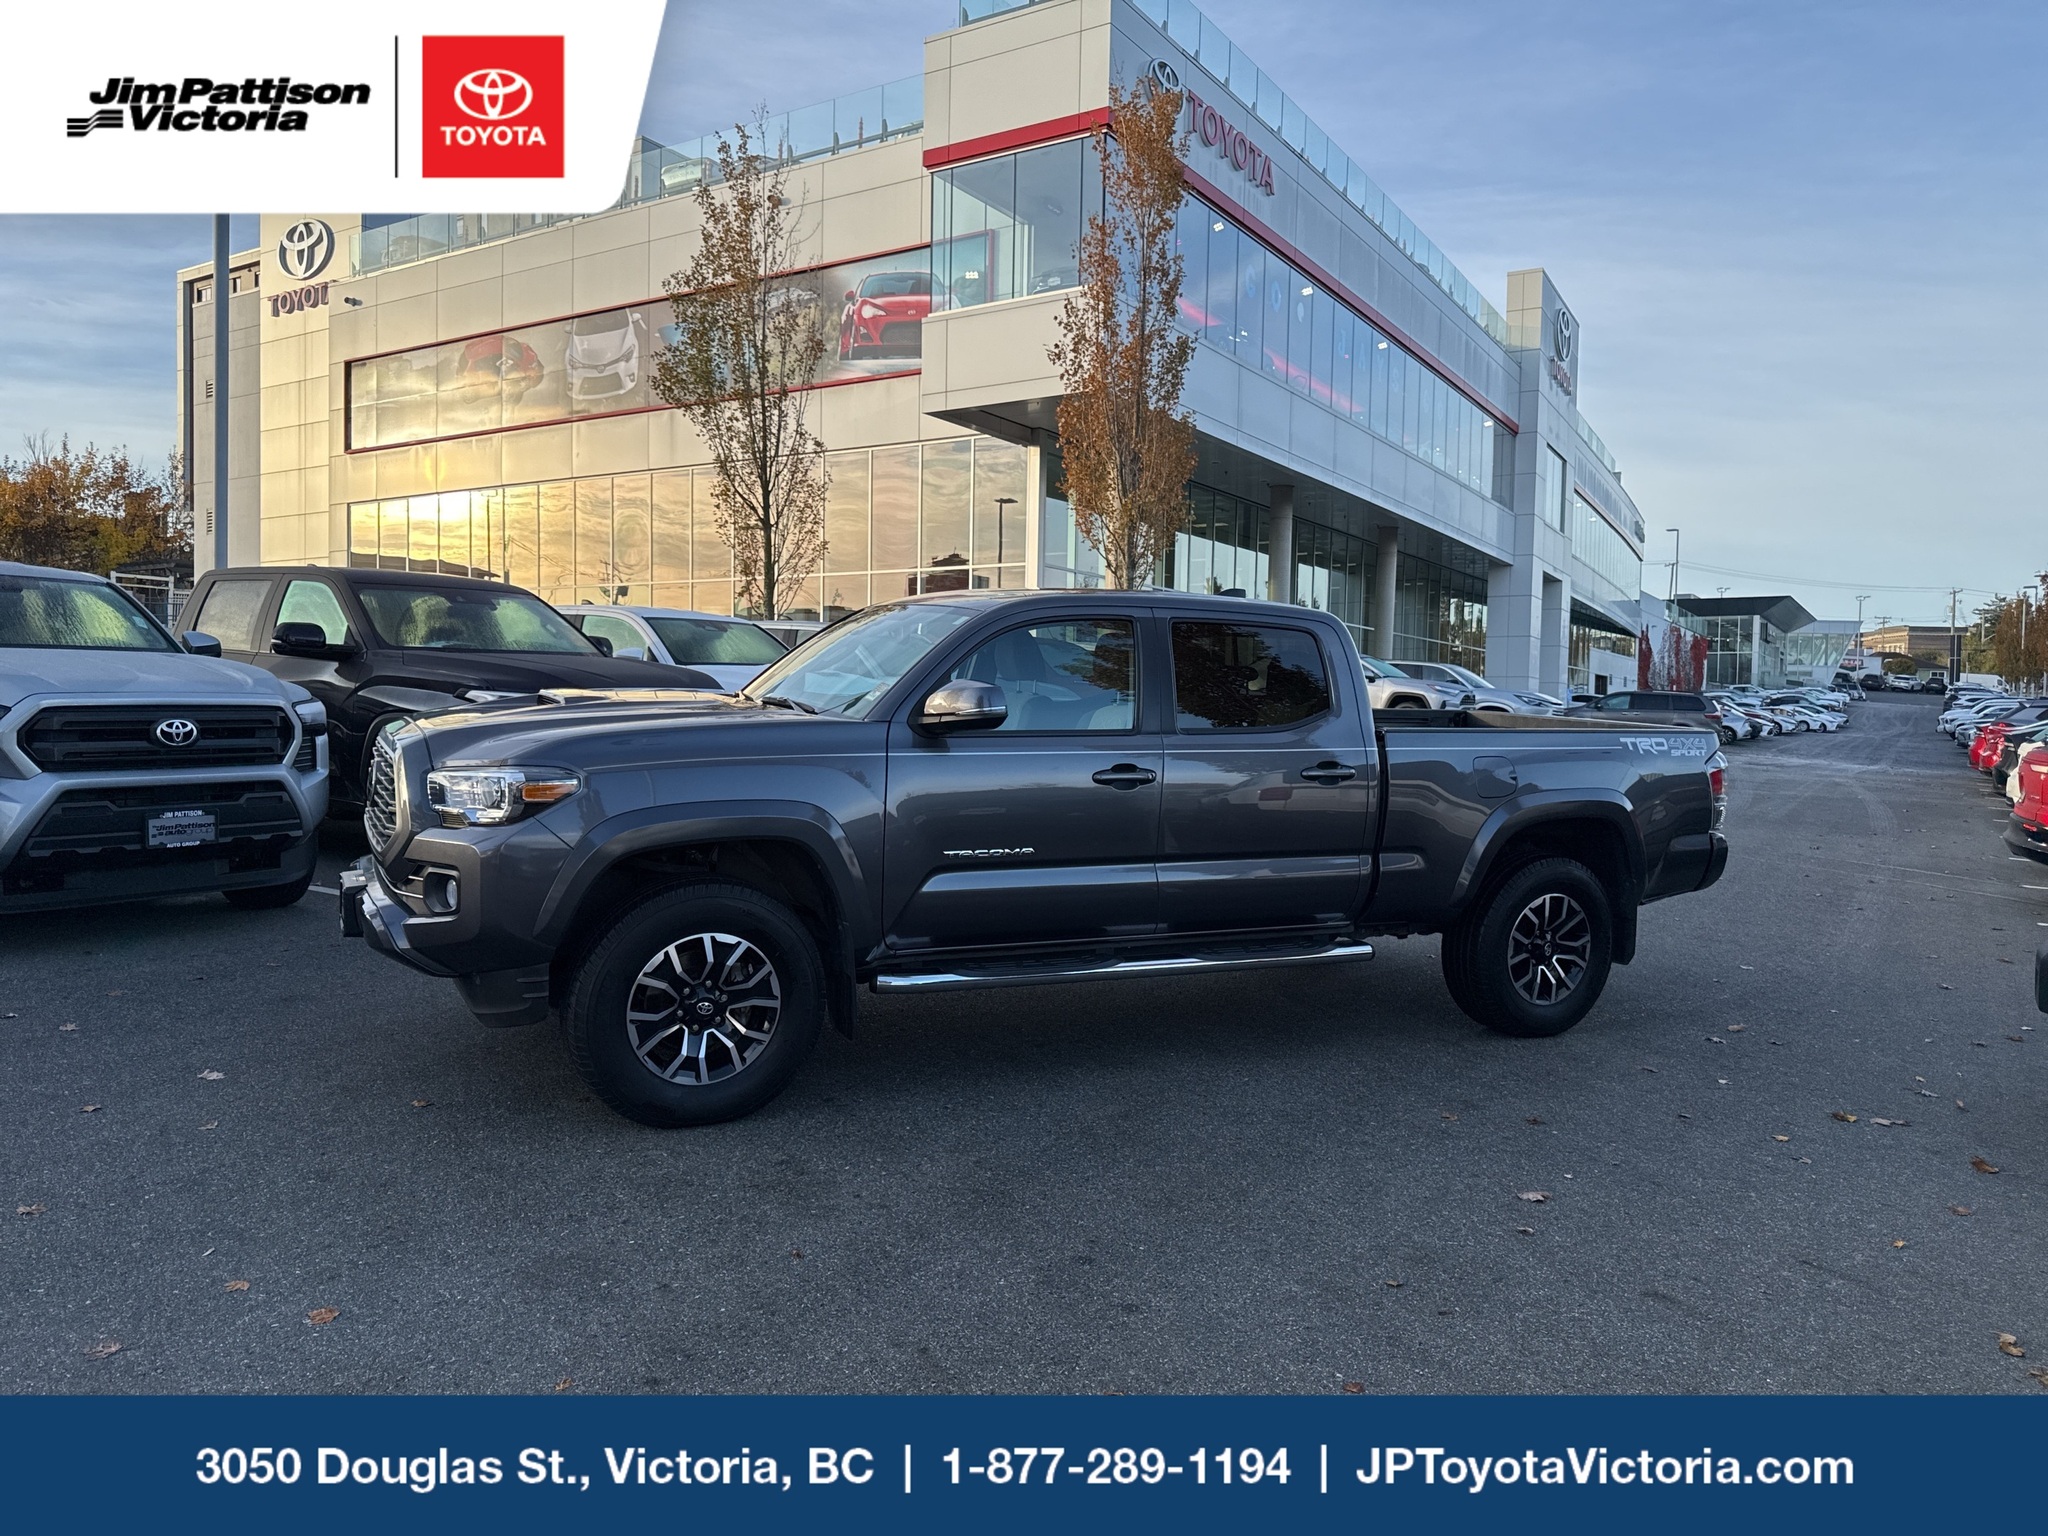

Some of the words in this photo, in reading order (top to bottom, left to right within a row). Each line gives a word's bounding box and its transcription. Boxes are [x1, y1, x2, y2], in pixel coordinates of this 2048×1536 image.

[1186, 89, 1275, 196] TOYOTA
[267, 281, 329, 317] TOYOT
[1620, 737, 1668, 754] TRD
[1671, 749, 1708, 757] SPORT
[174, 810, 202, 818] PATTISON
[942, 847, 1036, 859] TACOMA
